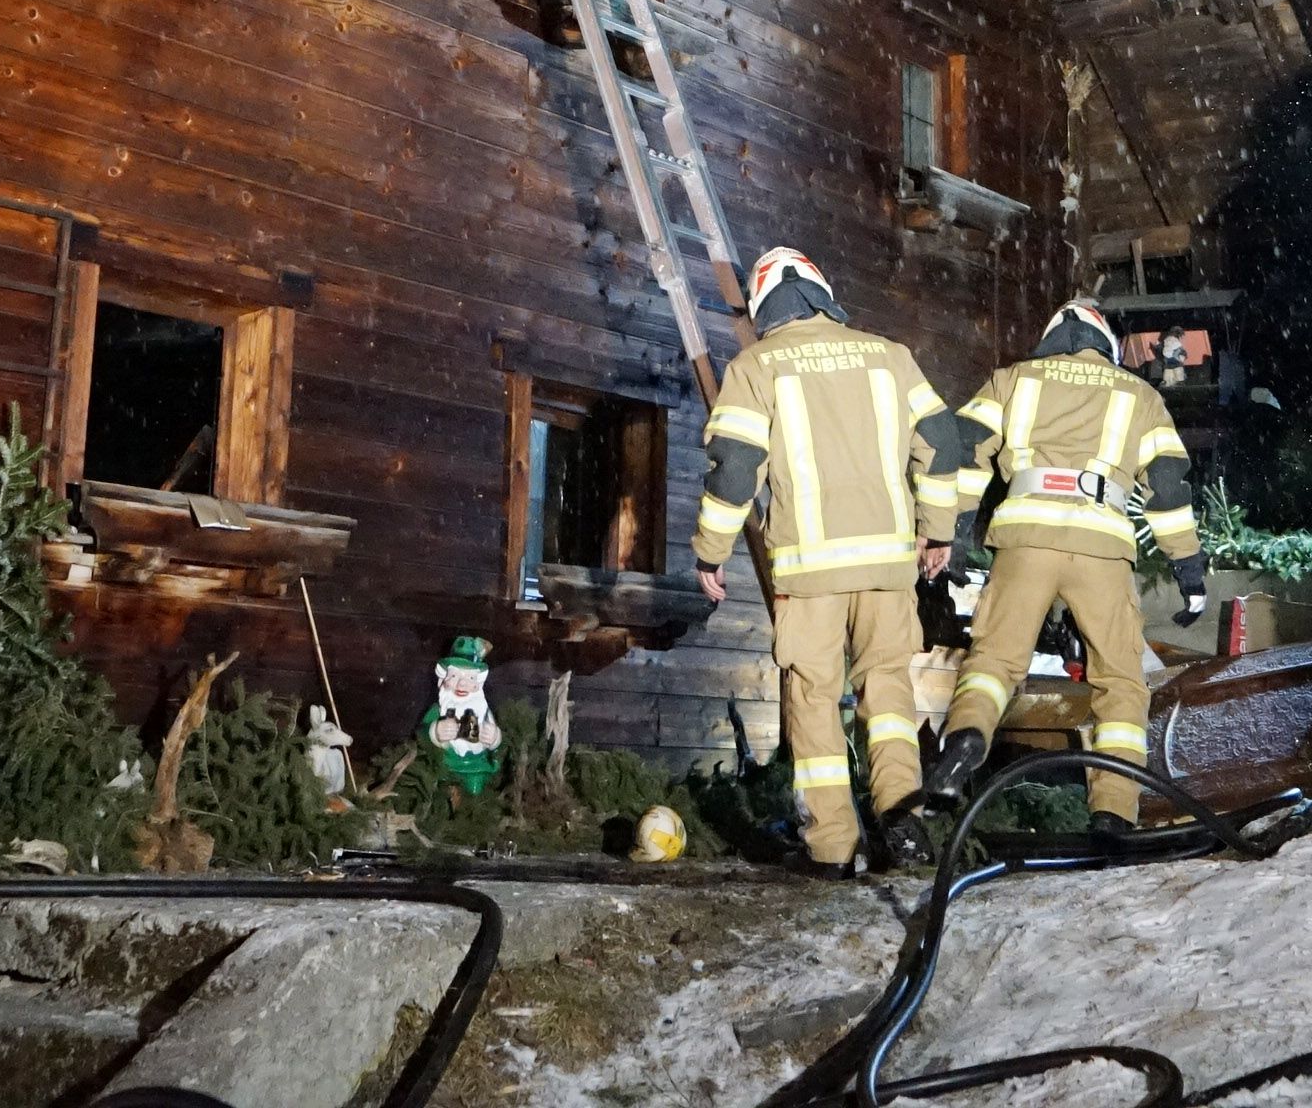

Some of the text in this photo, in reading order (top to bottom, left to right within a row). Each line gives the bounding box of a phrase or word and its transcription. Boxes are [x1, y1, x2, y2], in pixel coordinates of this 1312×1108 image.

[760, 342, 887, 366] FEUERWEHR
[794, 354, 865, 373] HUBEN
[1044, 369, 1114, 387] HUBEN
